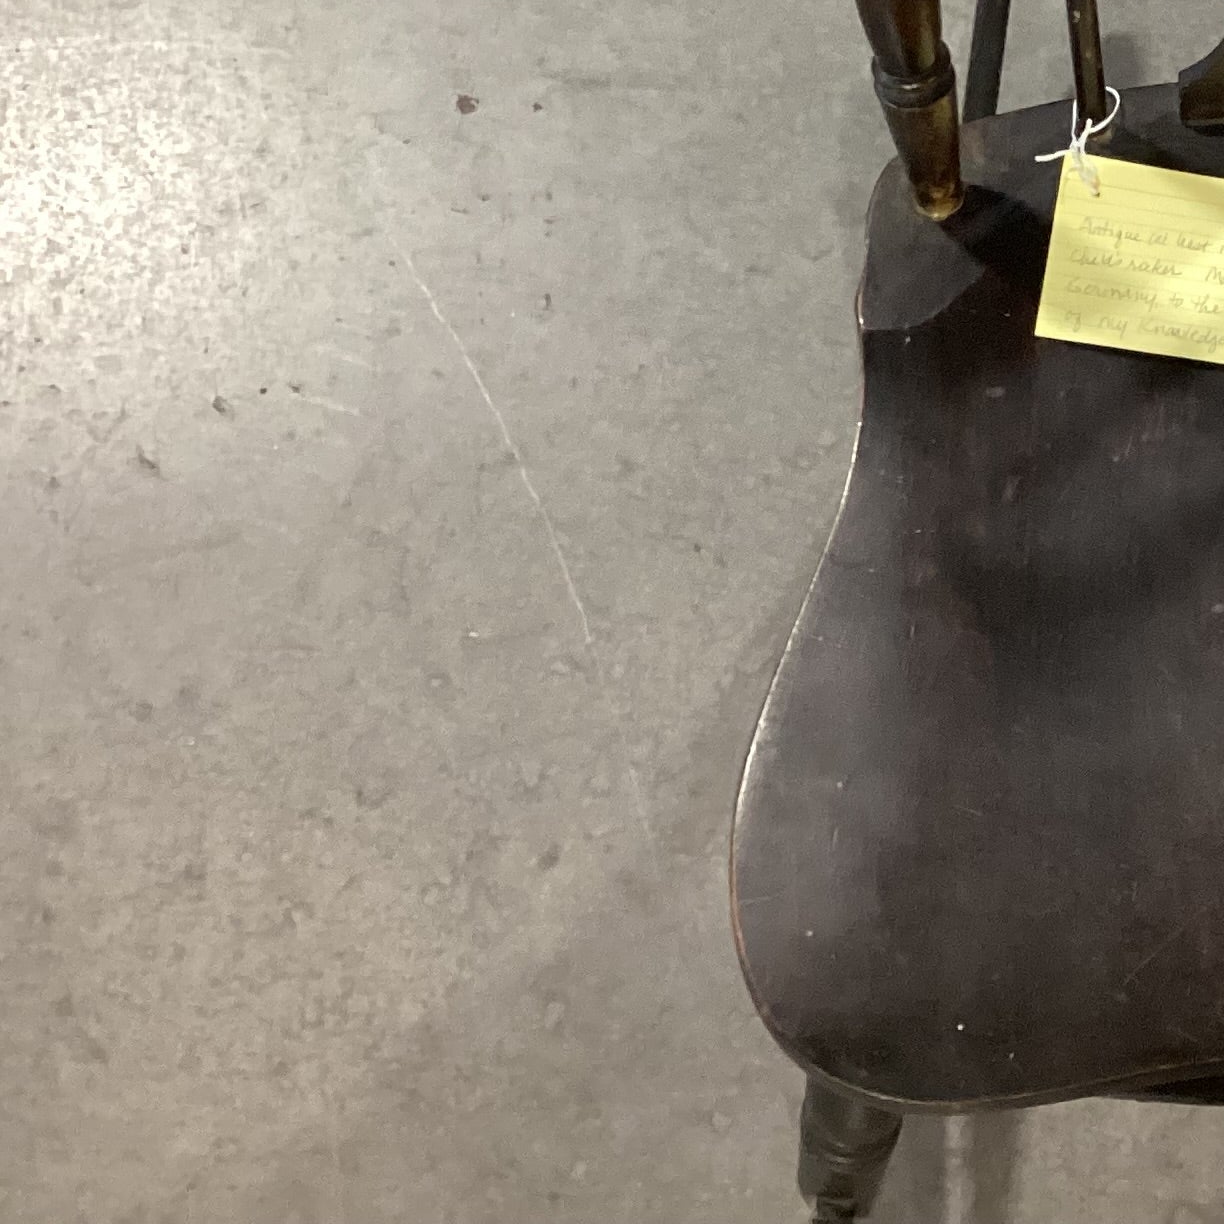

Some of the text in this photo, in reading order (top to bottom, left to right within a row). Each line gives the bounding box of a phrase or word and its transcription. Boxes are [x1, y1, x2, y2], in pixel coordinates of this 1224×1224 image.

[1080, 216, 1141, 249] Antique
[1176, 231, 1213, 252] least
[1169, 293, 1184, 308] to
[1190, 294, 1222, 314] the
[1064, 311, 1081, 332] of
[1098, 317, 1128, 338] my
